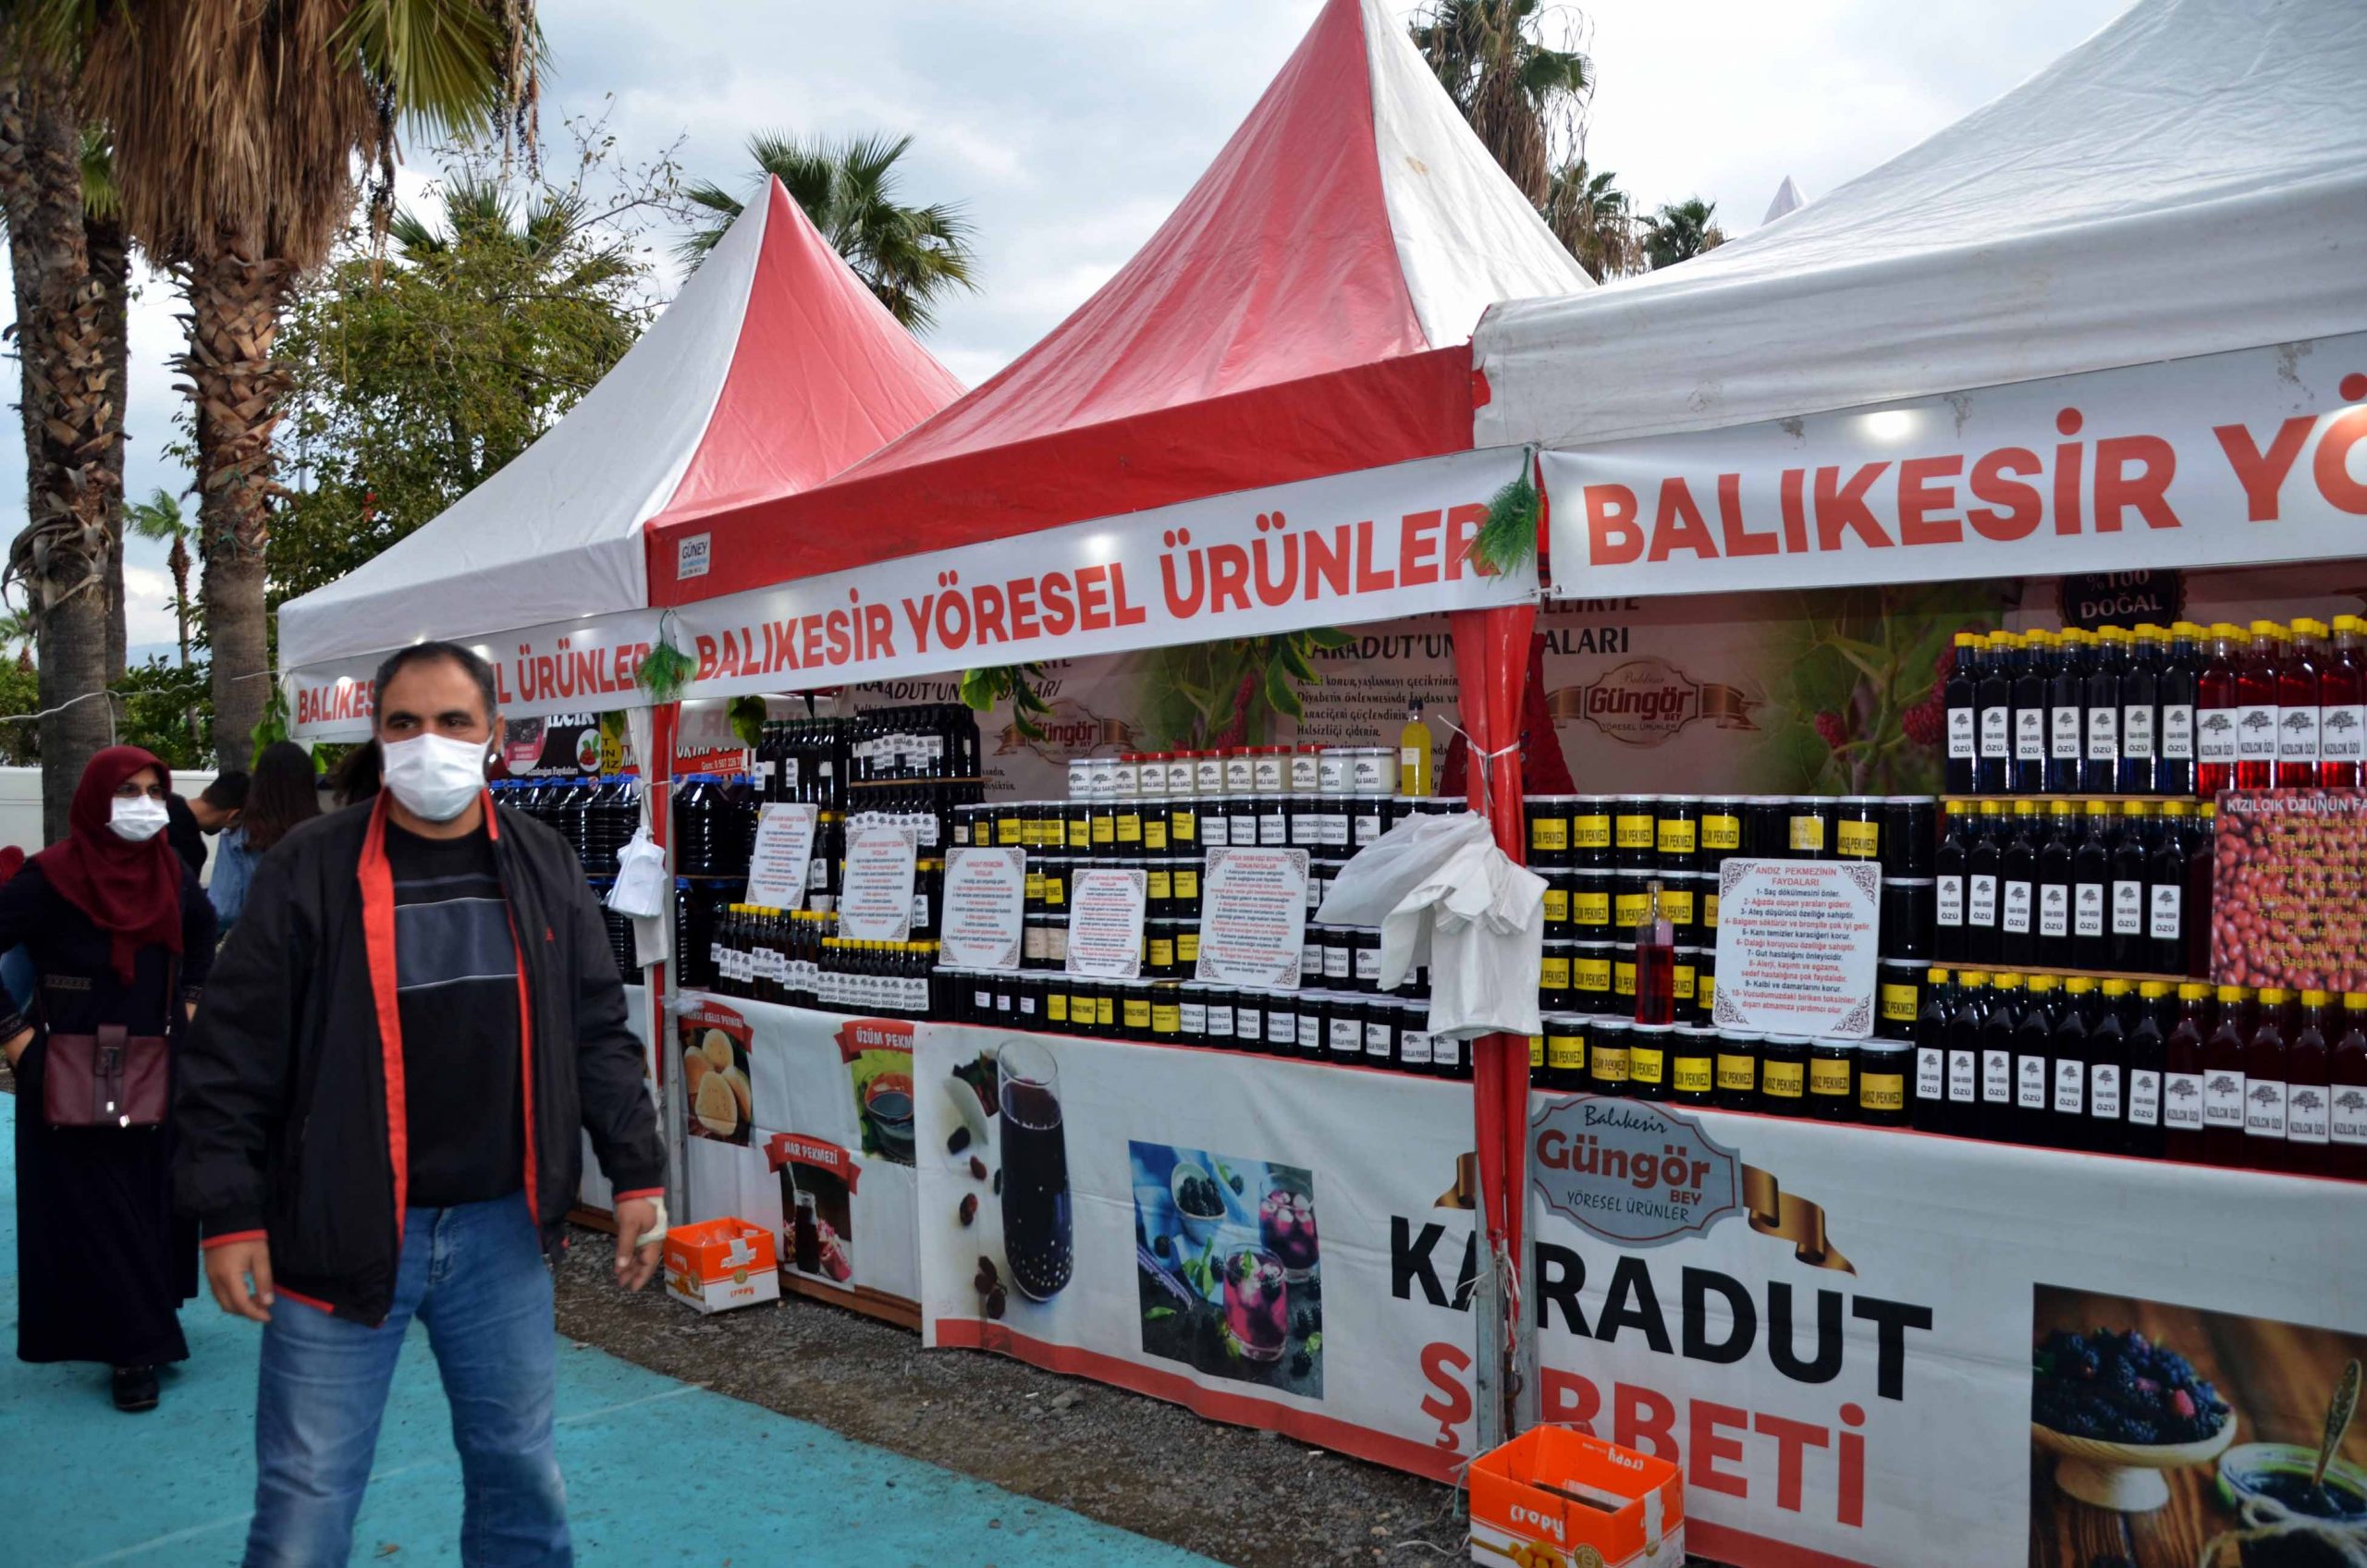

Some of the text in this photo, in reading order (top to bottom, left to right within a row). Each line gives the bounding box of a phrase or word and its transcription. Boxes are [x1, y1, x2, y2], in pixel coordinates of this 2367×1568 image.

[1584, 408, 2180, 566] BALIKESİR
[695, 503, 1500, 681] BALIKESİR YÖRESEL ÜRÜNLER
[2081, 594, 2163, 619] DOĞAL
[297, 675, 374, 724] BALIKES
[1589, 687, 1695, 721] Güngör
[1785, 866, 1836, 876] PEKMEZİNİN
[1764, 888, 1776, 897] Saç
[1779, 888, 1819, 897] dökülmesini
[1821, 889, 1840, 898] önler.
[1766, 909, 1797, 917] düşürücü
[1796, 930, 1829, 938] karaciğeri
[1806, 952, 1844, 962] önleyicidir.
[1754, 980, 1770, 988] Kalbi
[1821, 985, 1842, 993] korur.
[856, 1027, 914, 1047] ÜZÜM PEKM
[1585, 1105, 1668, 1133] Balıkesir
[784, 1140, 839, 1166] NAR PEKMEZİ
[1537, 1129, 1711, 1189] Güngör
[1567, 1190, 1689, 1222] YÖRESEL ÜRÜNLER
[1670, 1189, 1702, 1206] BEY
[1420, 1341, 1866, 1529] ŞRBETİ
